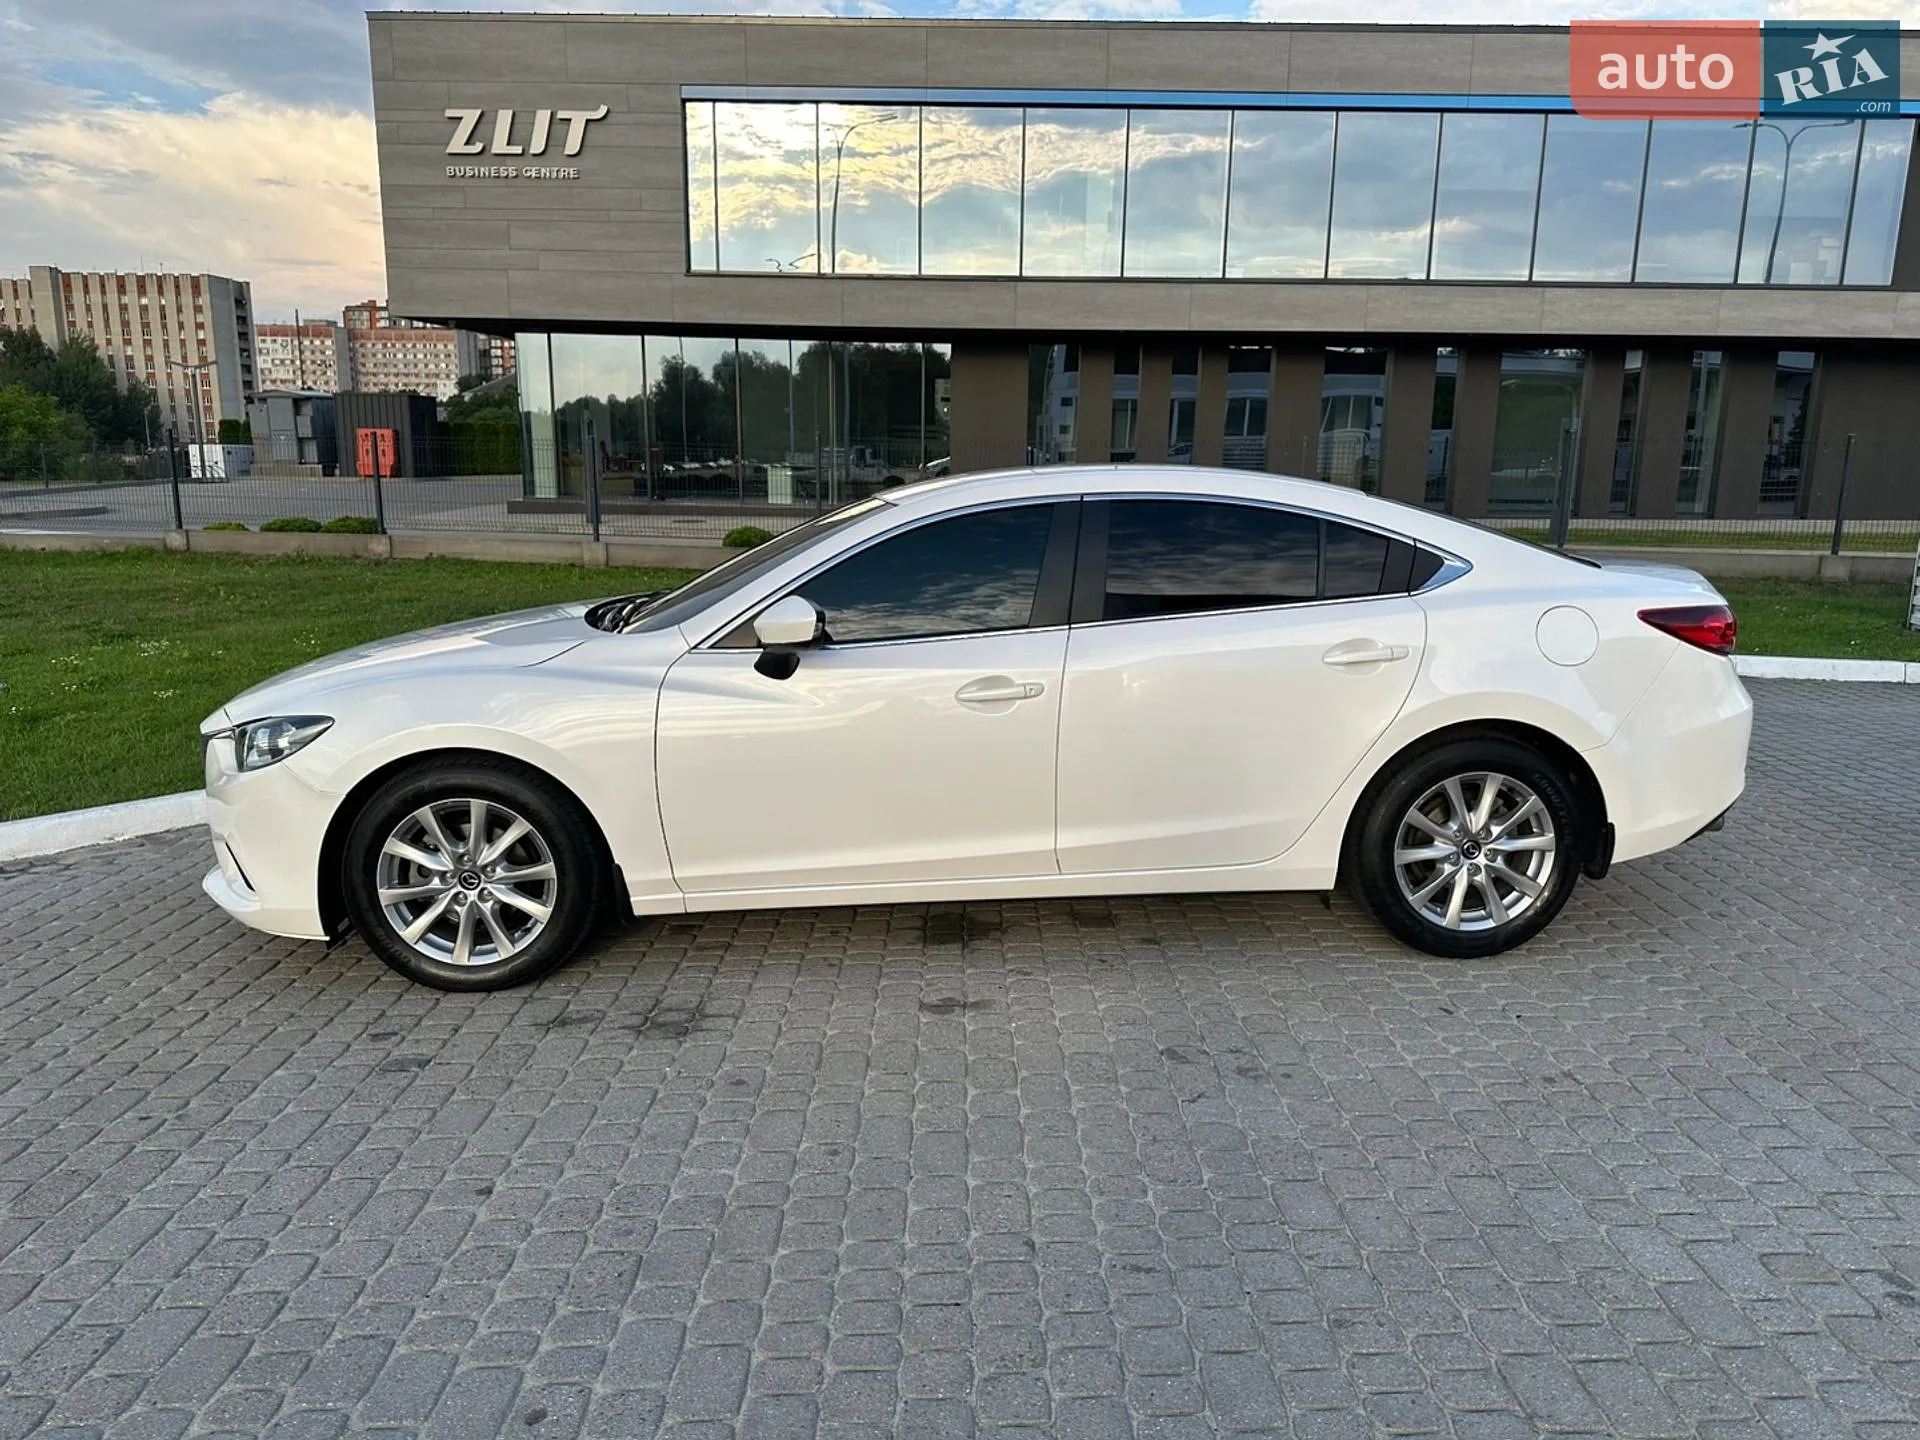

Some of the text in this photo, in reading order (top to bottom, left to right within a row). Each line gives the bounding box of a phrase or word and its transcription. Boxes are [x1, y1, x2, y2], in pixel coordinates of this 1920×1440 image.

[444, 104, 609, 156] ZLIT
[446, 166, 580, 179] BUSINESS CENTRE
